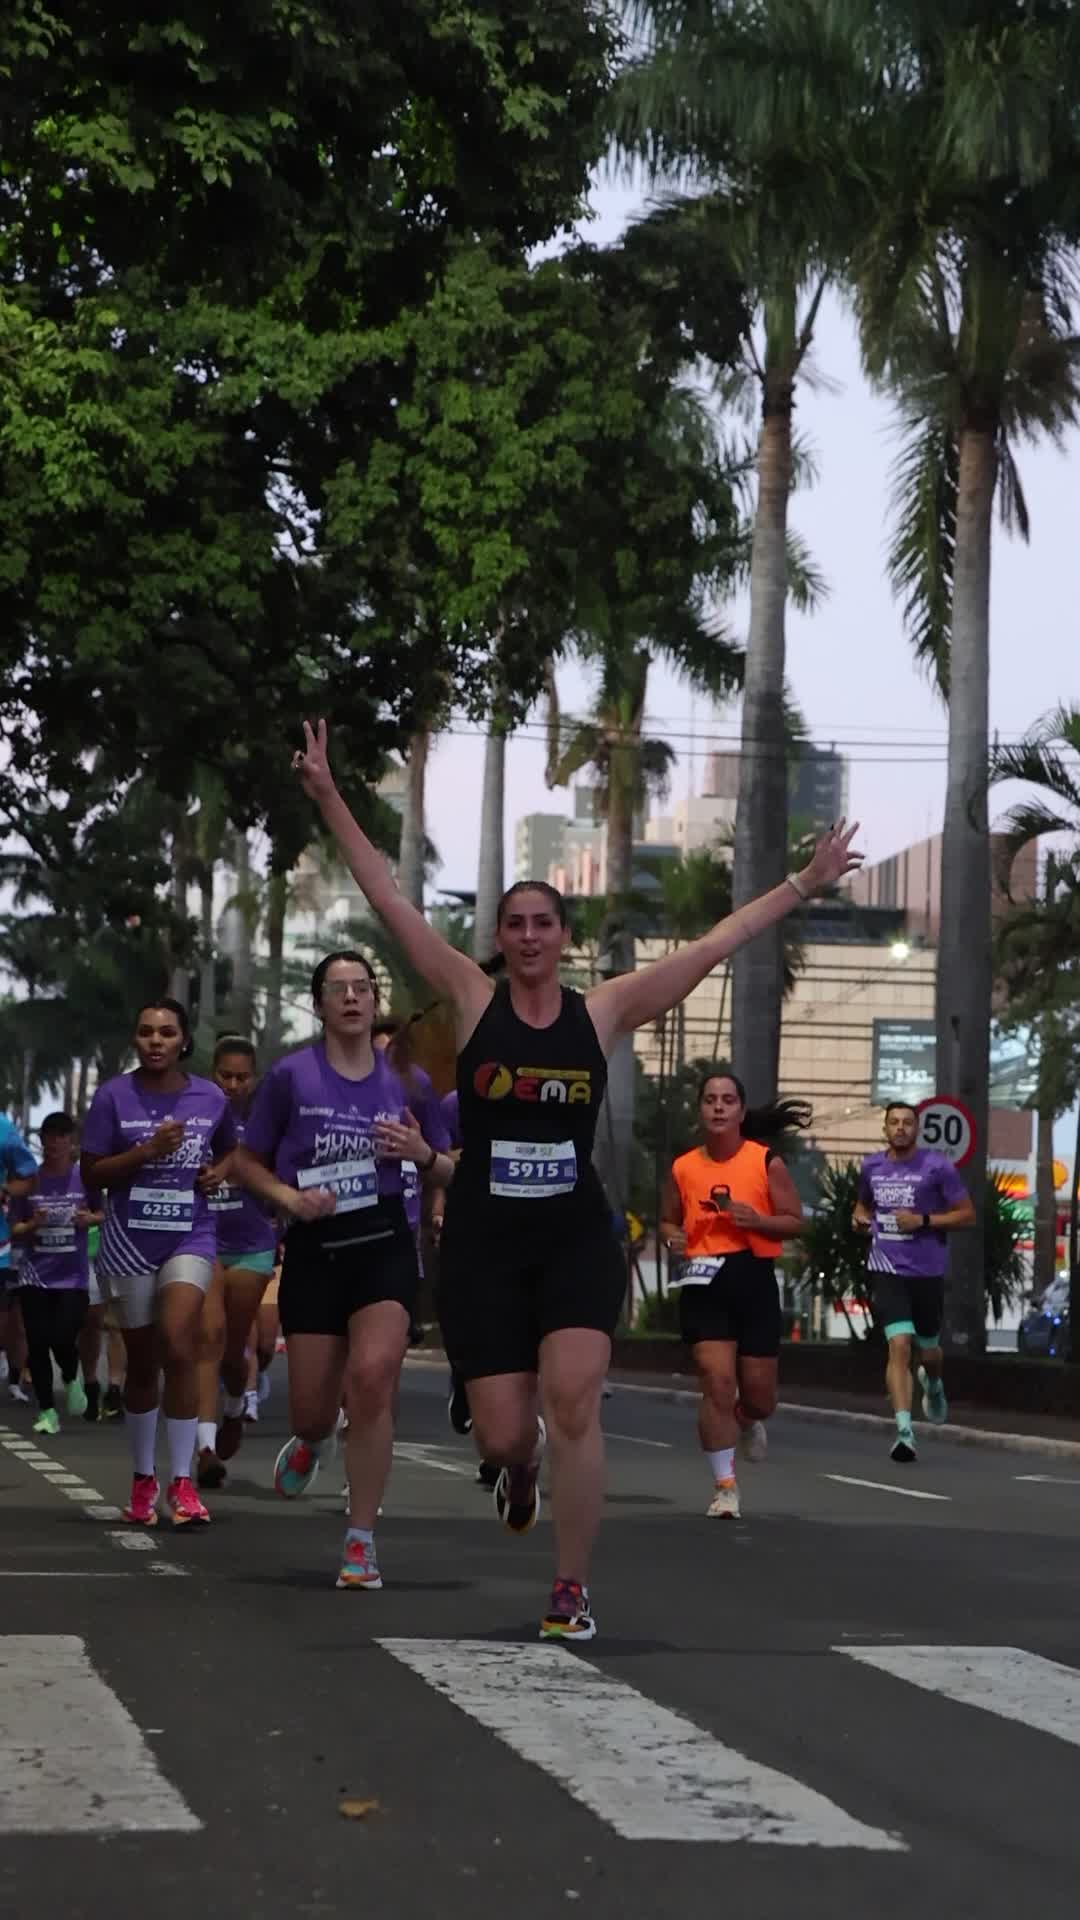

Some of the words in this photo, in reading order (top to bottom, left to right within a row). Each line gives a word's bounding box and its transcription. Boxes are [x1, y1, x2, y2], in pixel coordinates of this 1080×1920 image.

[514, 1076, 591, 1105] EMA
[922, 1113, 963, 1146] 50
[508, 1161, 559, 1178] 5915
[142, 1203, 181, 1217] 6255
